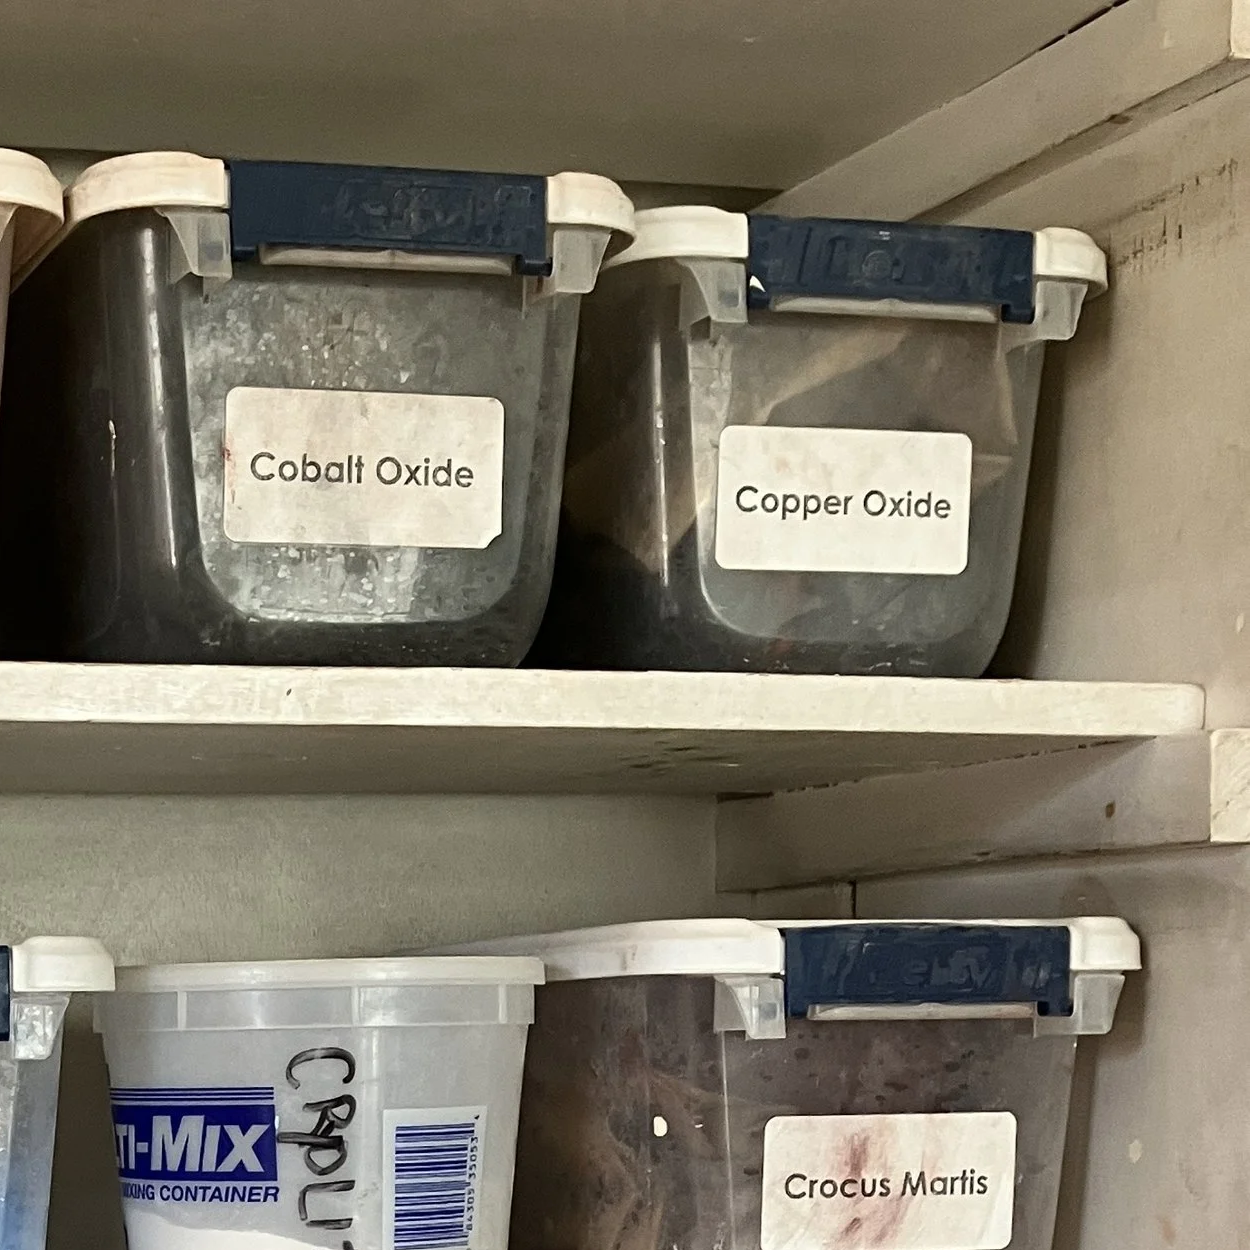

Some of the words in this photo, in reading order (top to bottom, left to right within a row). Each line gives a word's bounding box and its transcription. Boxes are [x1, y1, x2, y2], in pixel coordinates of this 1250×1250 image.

[250, 450, 366, 485] Cobalt
[375, 456, 475, 489] Oxide
[734, 484, 854, 522] Copper
[862, 490, 952, 520] Oxide
[115, 1114, 271, 1173] TI-MIX
[159, 1185, 280, 1203] CONTAINER
[783, 1172, 892, 1201] Crocus
[900, 1168, 988, 1199] Martis
